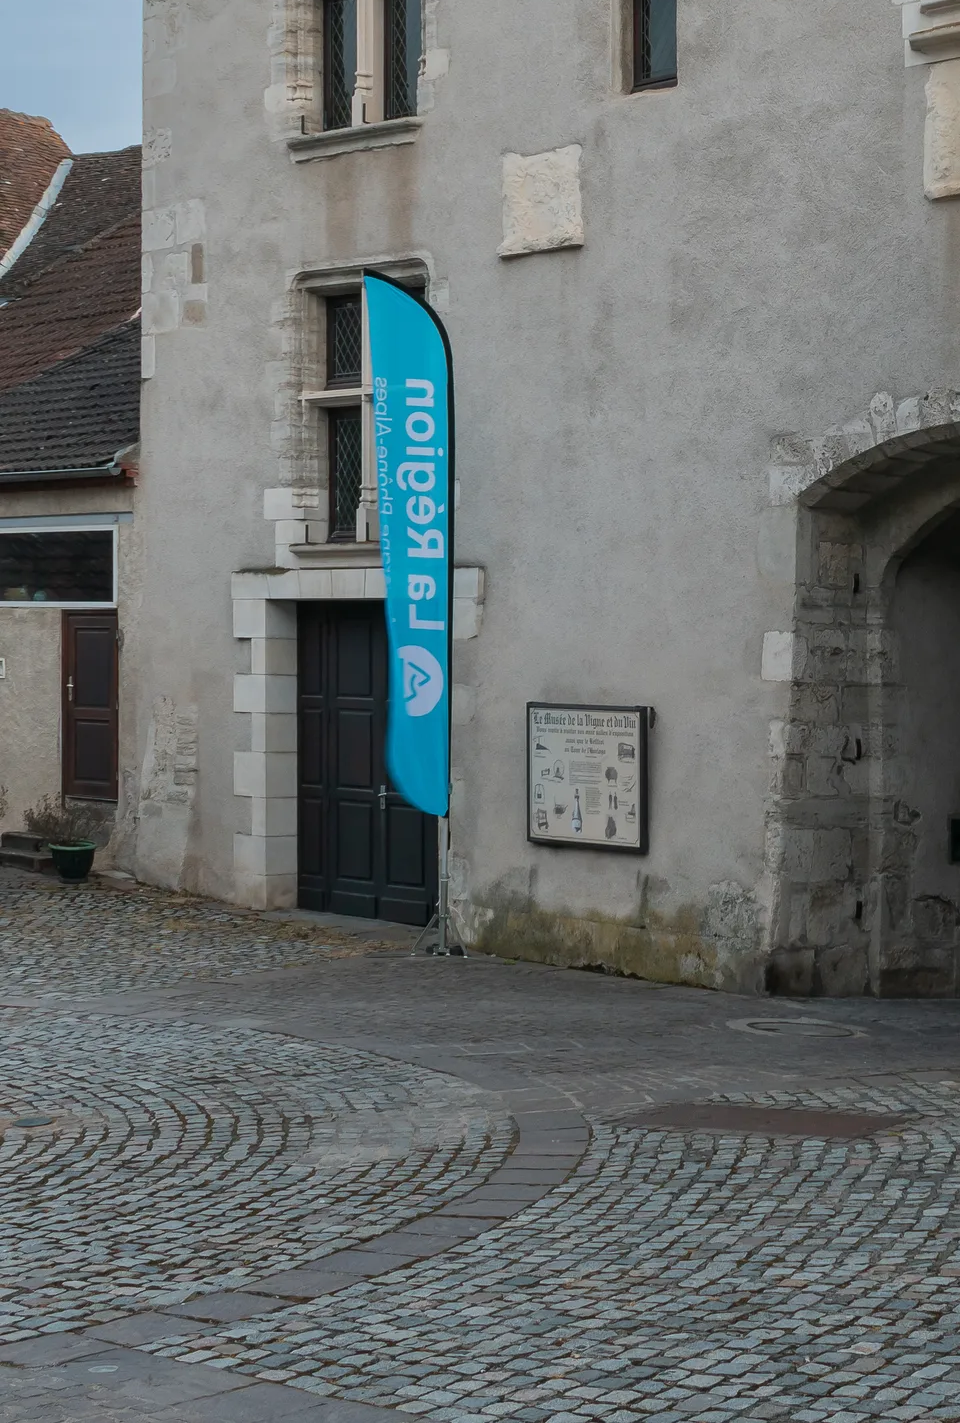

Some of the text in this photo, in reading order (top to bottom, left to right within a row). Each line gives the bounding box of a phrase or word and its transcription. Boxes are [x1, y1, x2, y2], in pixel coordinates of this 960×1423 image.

[533, 711, 636, 729] Le Musée de la Vigne et du Vin
